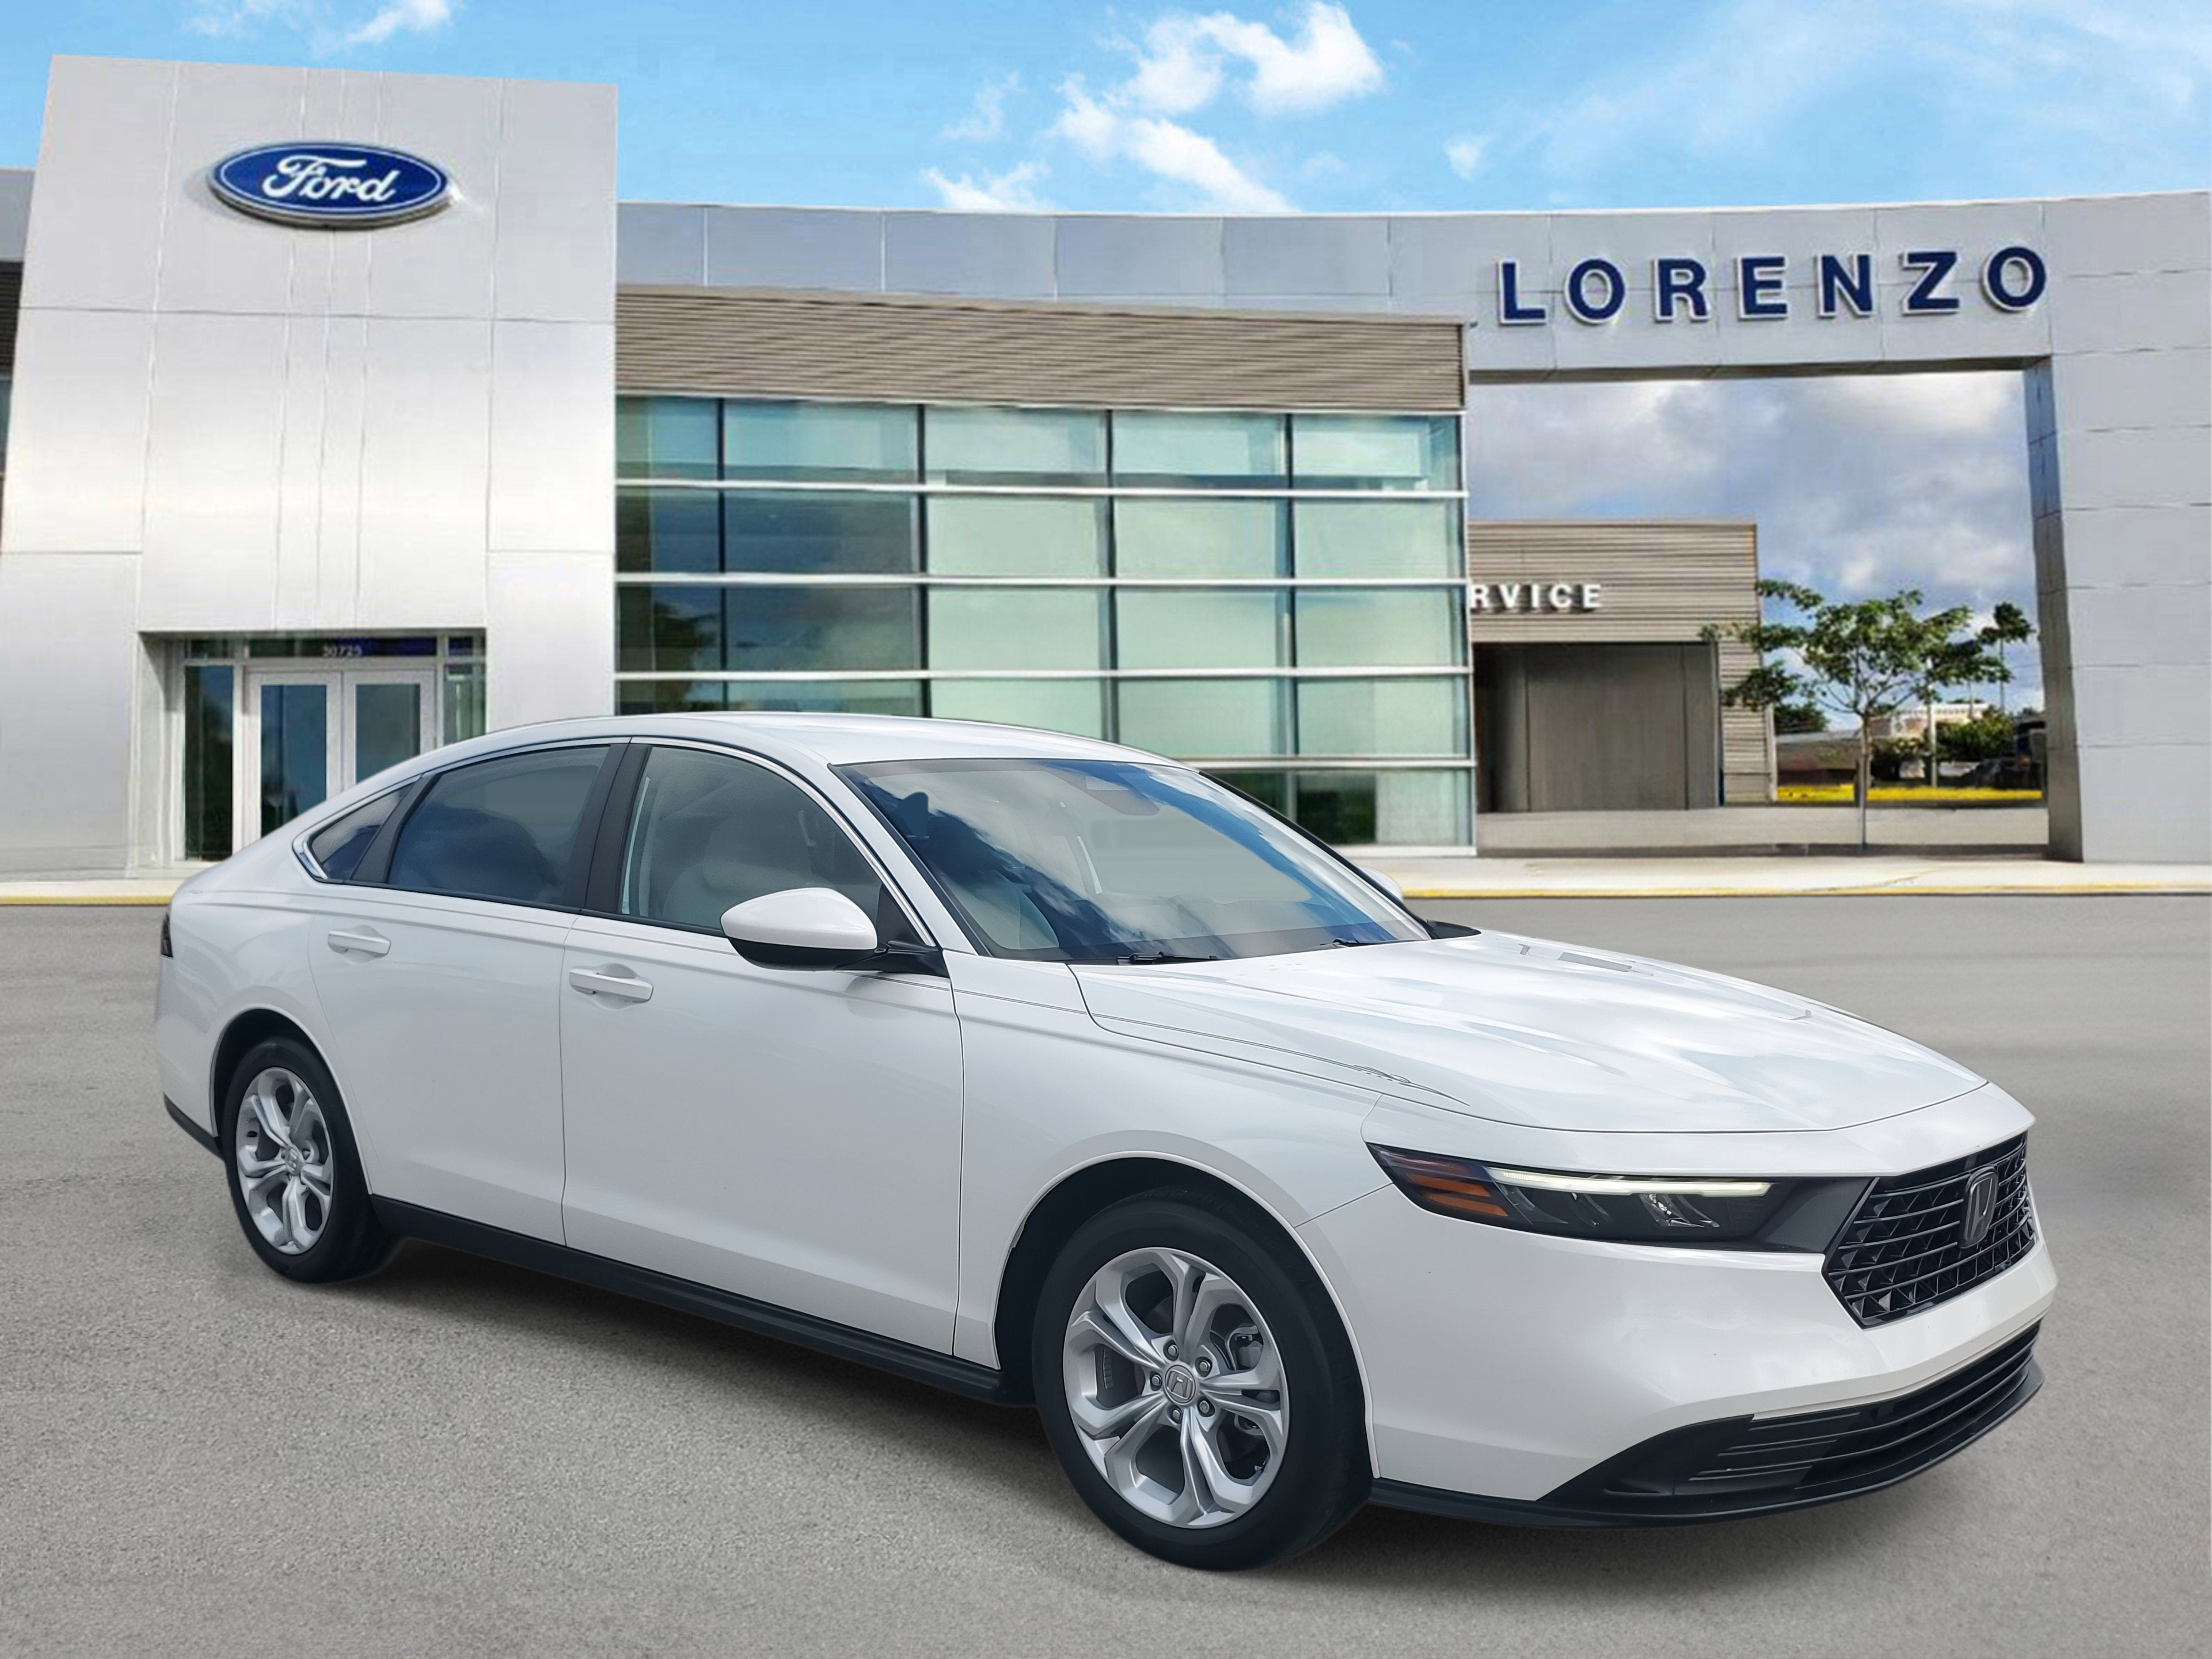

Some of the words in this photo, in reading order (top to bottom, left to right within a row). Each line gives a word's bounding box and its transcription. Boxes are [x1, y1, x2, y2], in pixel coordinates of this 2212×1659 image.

[262, 154, 401, 203] Ford
[1499, 246, 2047, 324] LORENZO
[1470, 583, 1602, 608] RVICE
